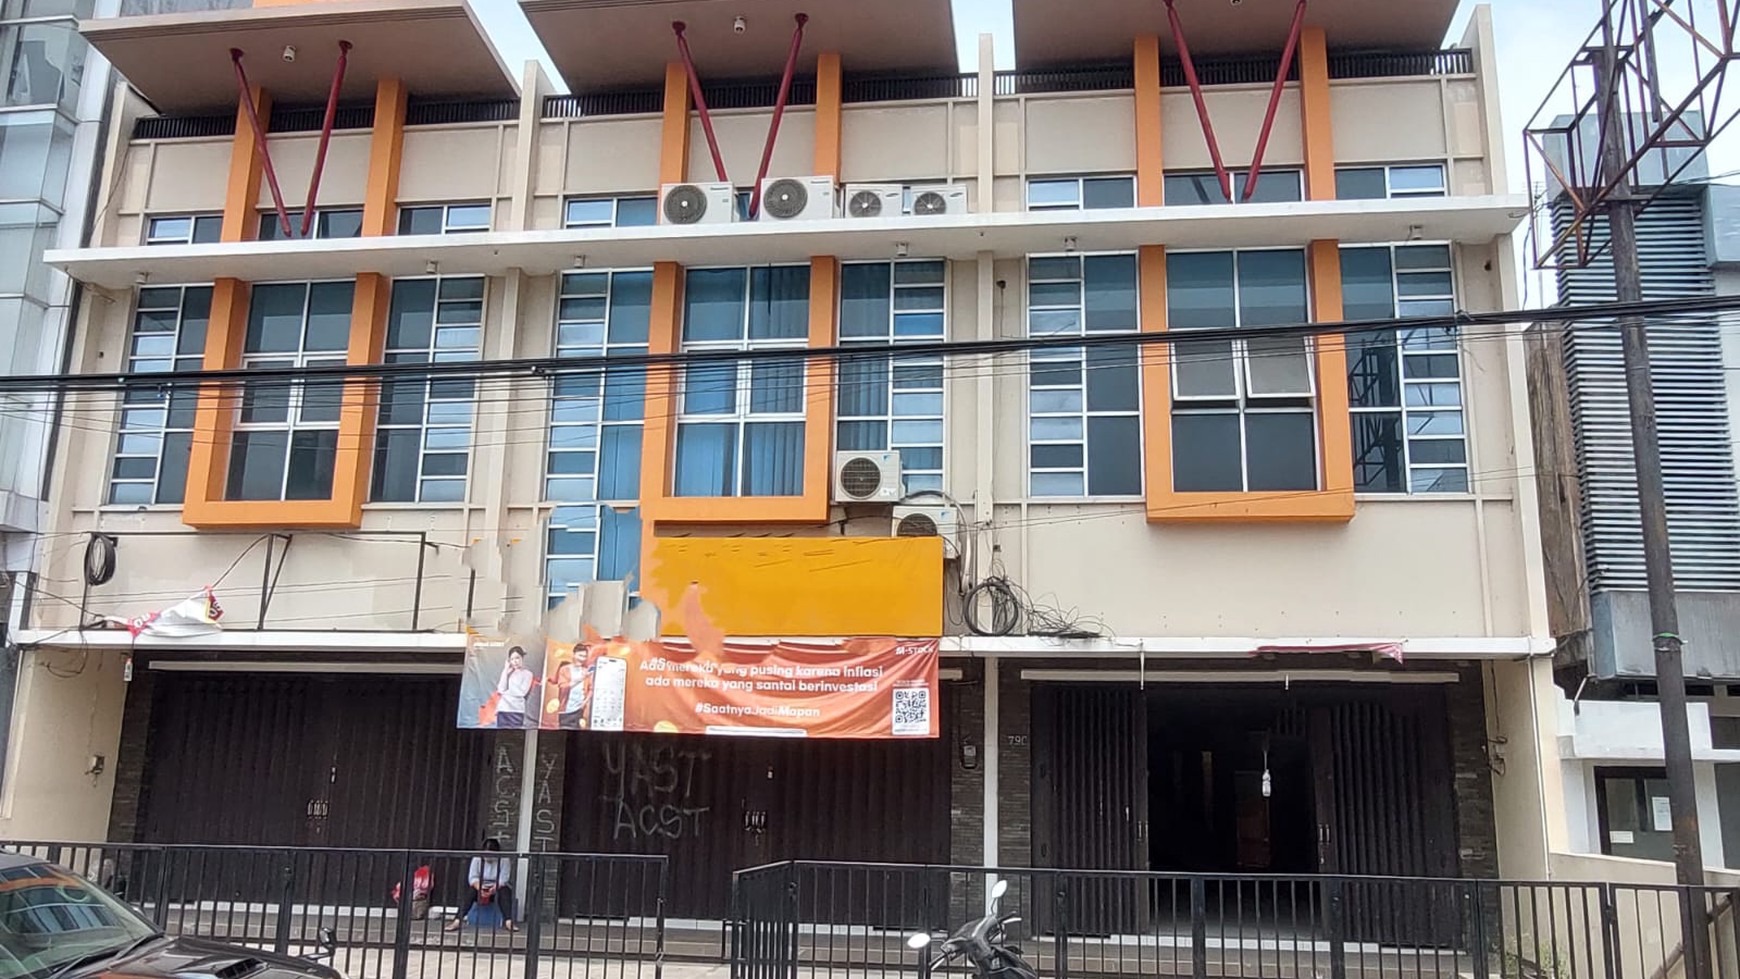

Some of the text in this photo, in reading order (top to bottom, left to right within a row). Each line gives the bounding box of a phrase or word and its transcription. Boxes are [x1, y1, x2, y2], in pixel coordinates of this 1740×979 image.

[750, 665, 793, 678] pusing
[796, 666, 841, 676] karena
[844, 666, 883, 677] inflasi
[645, 676, 878, 692] ada mereka yang santai berinvestasi
[695, 703, 820, 717] #SaatnyaJadiMapan
